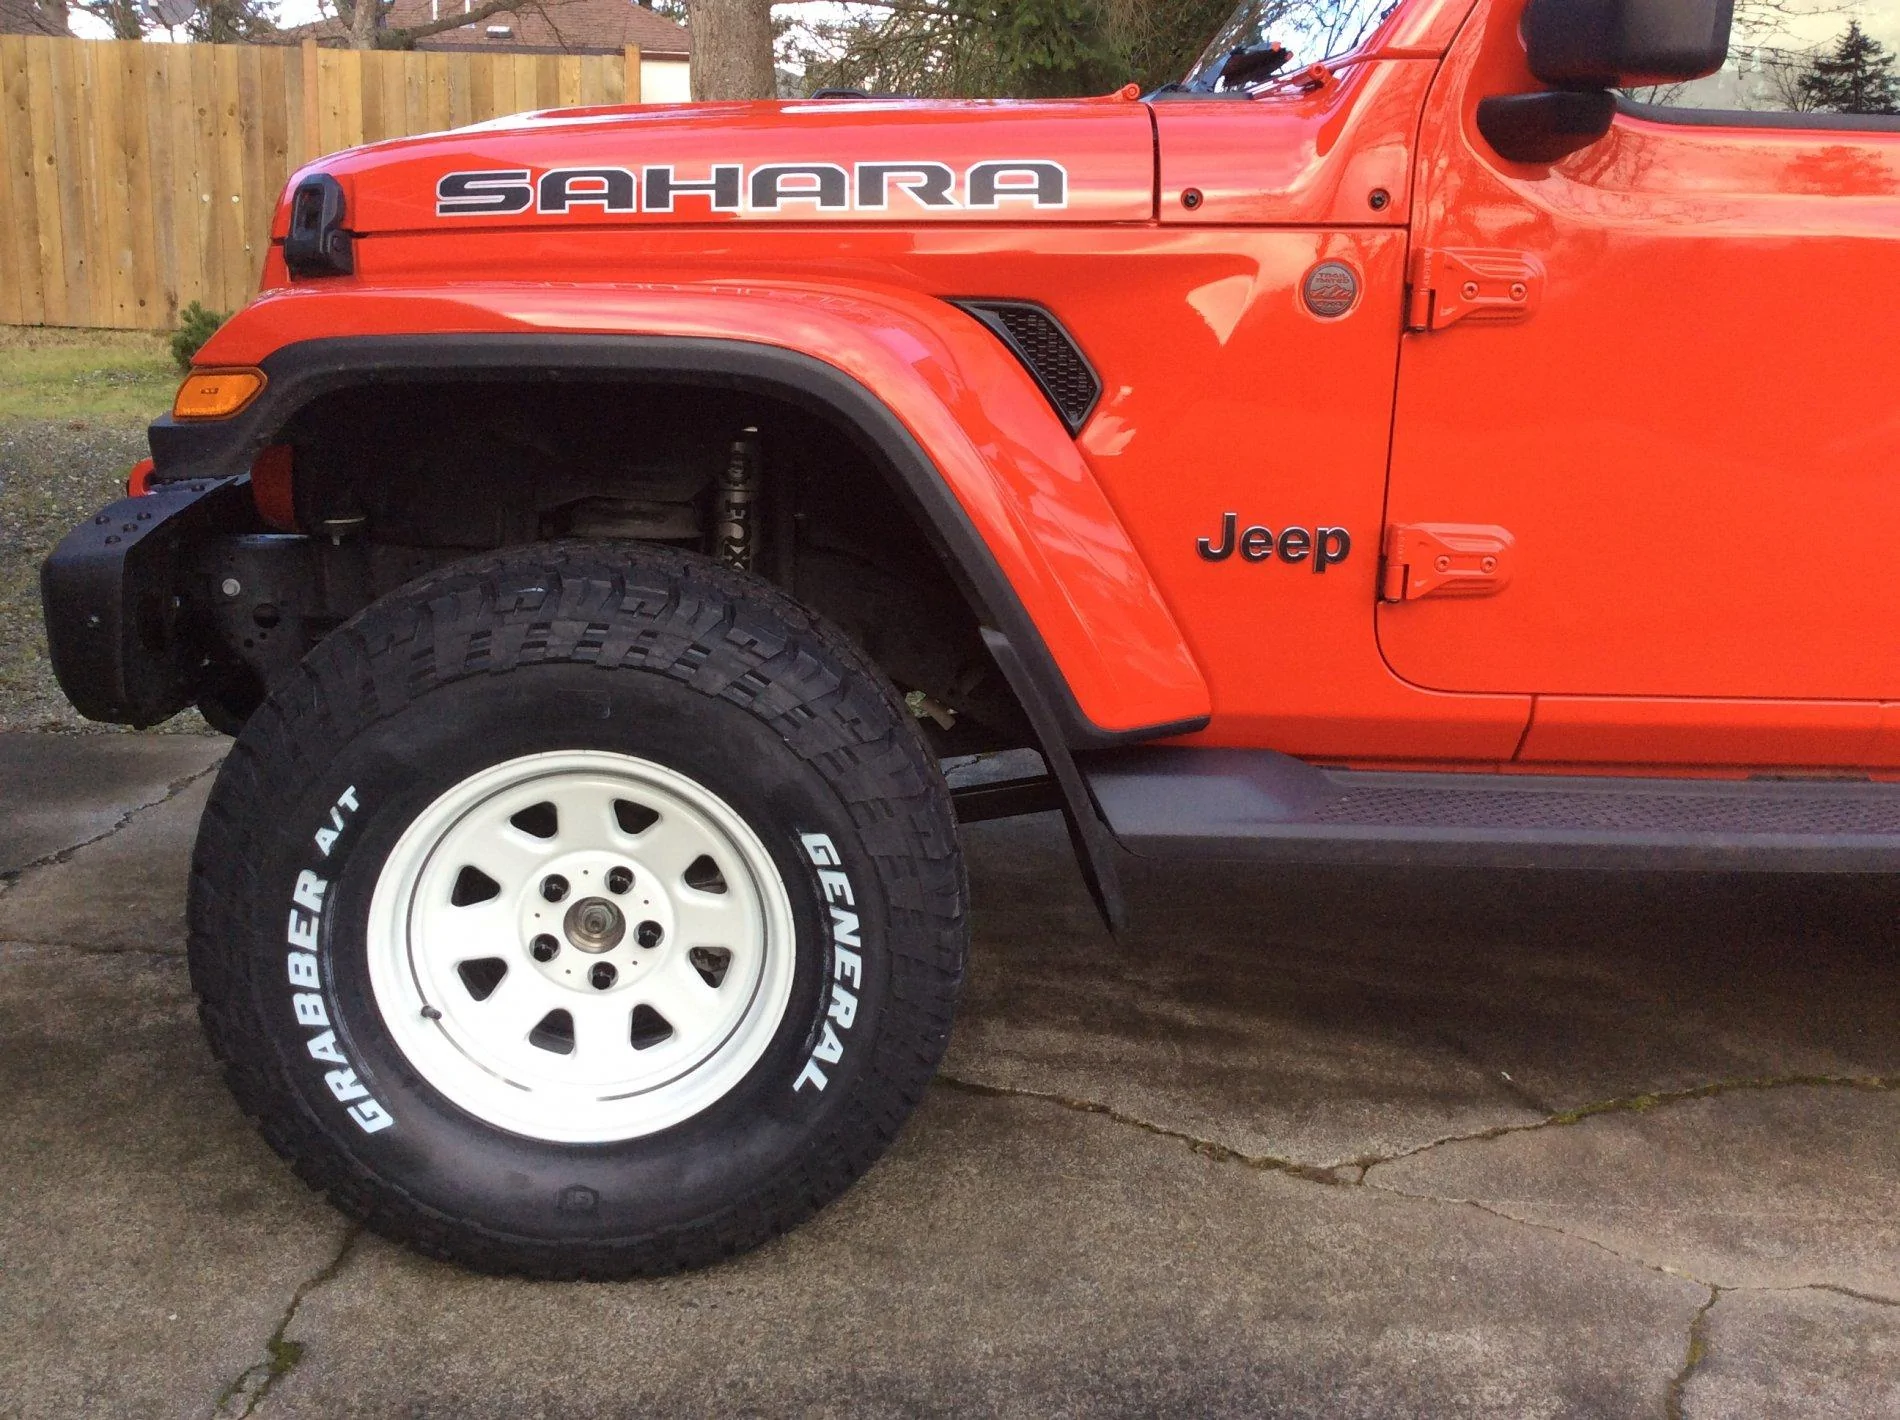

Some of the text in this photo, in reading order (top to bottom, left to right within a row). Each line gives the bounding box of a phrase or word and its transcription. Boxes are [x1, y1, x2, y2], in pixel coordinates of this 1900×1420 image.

[435, 159, 1068, 217] SAHARA
[1196, 512, 1351, 574] Jeep
[287, 785, 395, 1134] GRABBER A/T
[792, 832, 862, 1092] GENERAL
